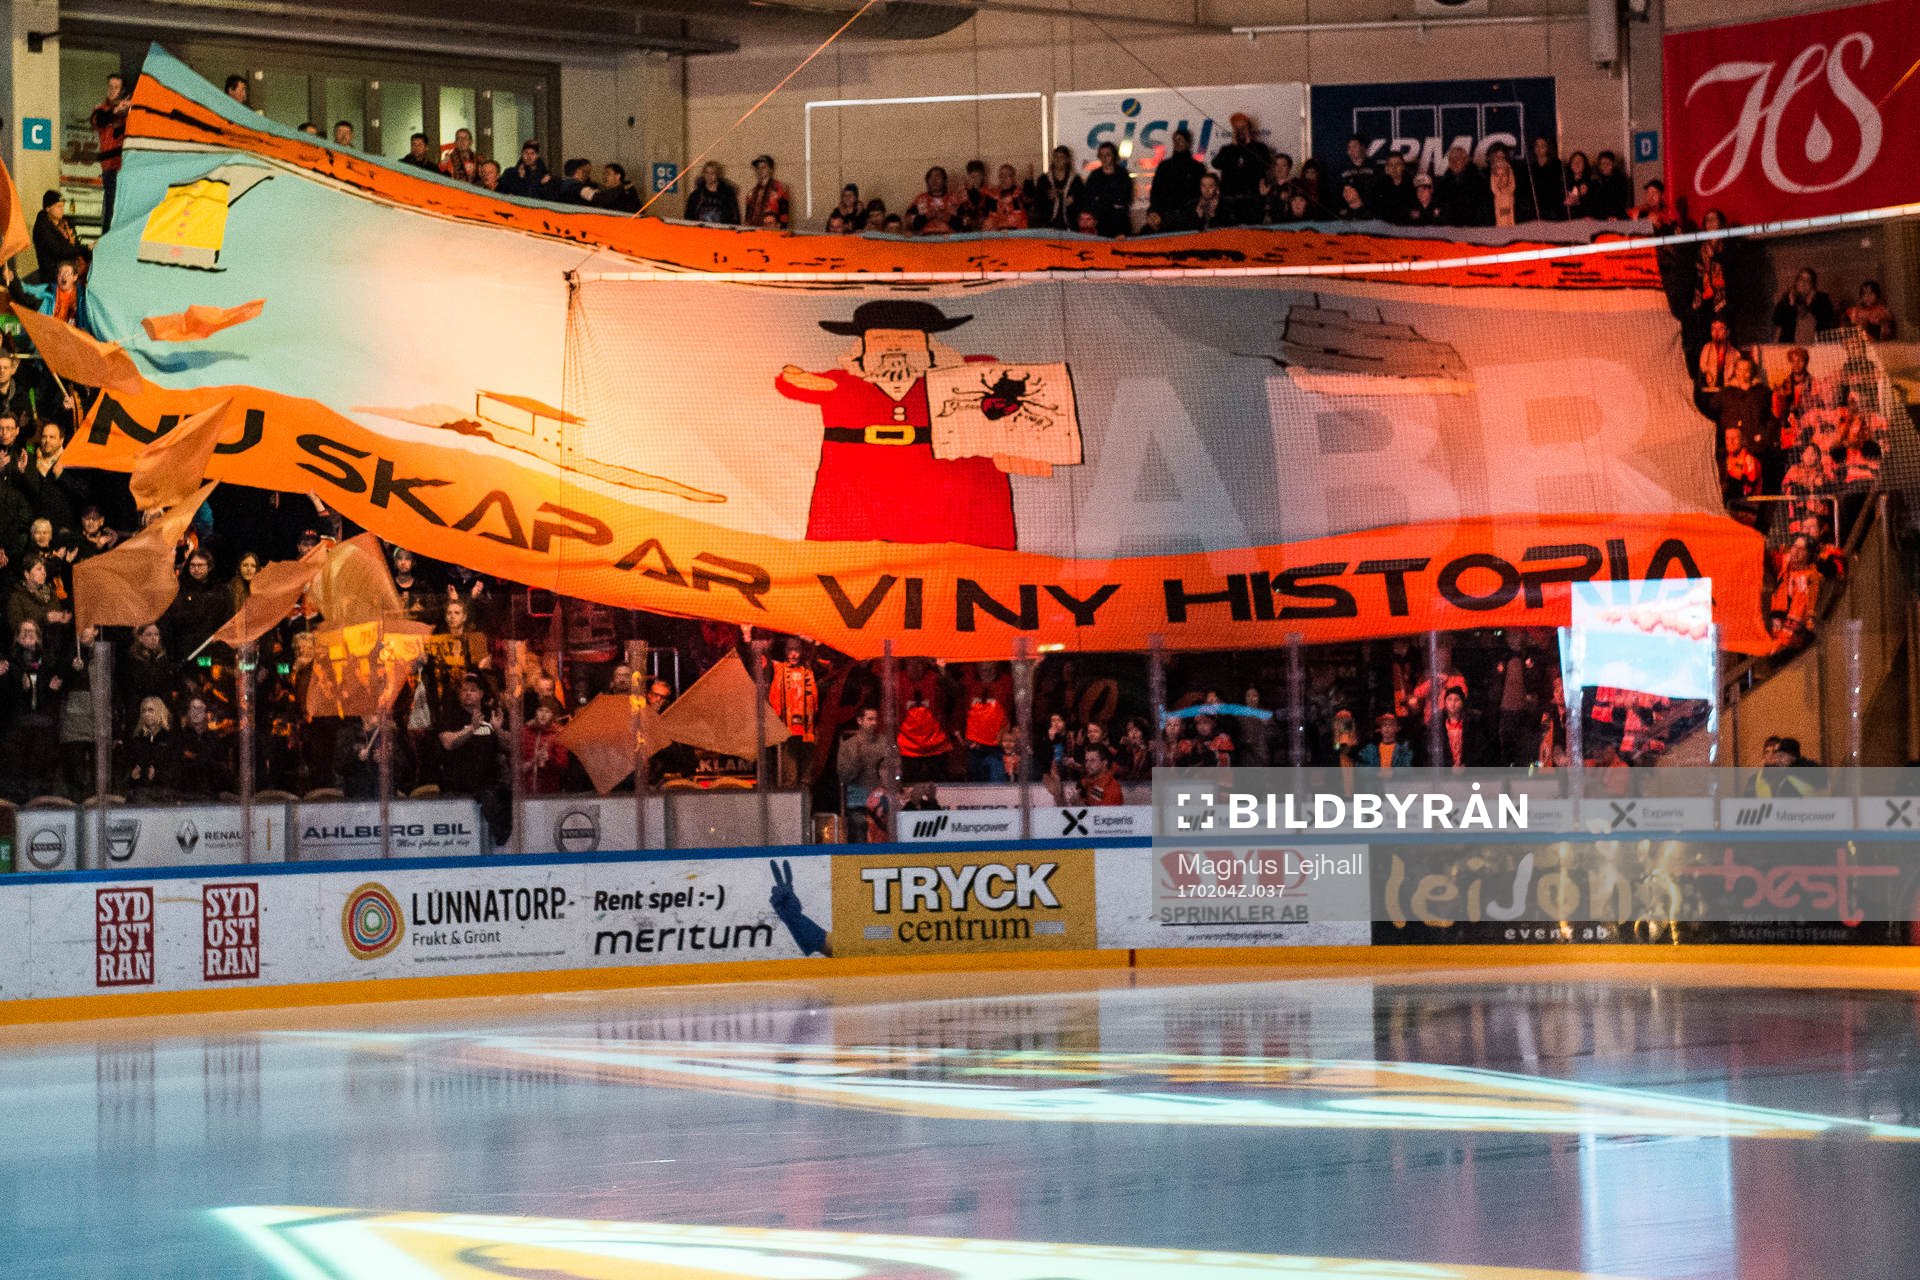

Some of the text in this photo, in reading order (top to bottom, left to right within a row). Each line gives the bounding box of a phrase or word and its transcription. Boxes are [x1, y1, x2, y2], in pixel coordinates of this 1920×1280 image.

[31, 124, 43, 144] C
[1641, 138, 1651, 156] D
[88, 392, 265, 455] NU
[296, 433, 771, 612] SKAPAR
[956, 577, 1122, 632] NY
[951, 821, 1010, 834] Manpower
[1093, 814, 1134, 826] Experis
[1776, 810, 1837, 823] Manpower
[204, 830, 257, 841] RENAUT
[302, 822, 473, 840] AHLBERG BIL
[594, 890, 644, 912] Rent
[648, 886, 694, 913] spel
[861, 862, 1062, 914] TRYCK
[100, 891, 151, 922] SYD
[206, 887, 256, 918] SYD
[1160, 904, 1309, 924] SPRINKLER AB
[101, 923, 151, 952] OST
[207, 917, 256, 947] OST
[412, 929, 501, 946] Frukt & Grönt
[594, 924, 773, 955] meritum
[899, 916, 1031, 943] centrum
[1582, 924, 1609, 940] ab
[100, 953, 153, 982] RAN
[206, 947, 257, 976] RAN
